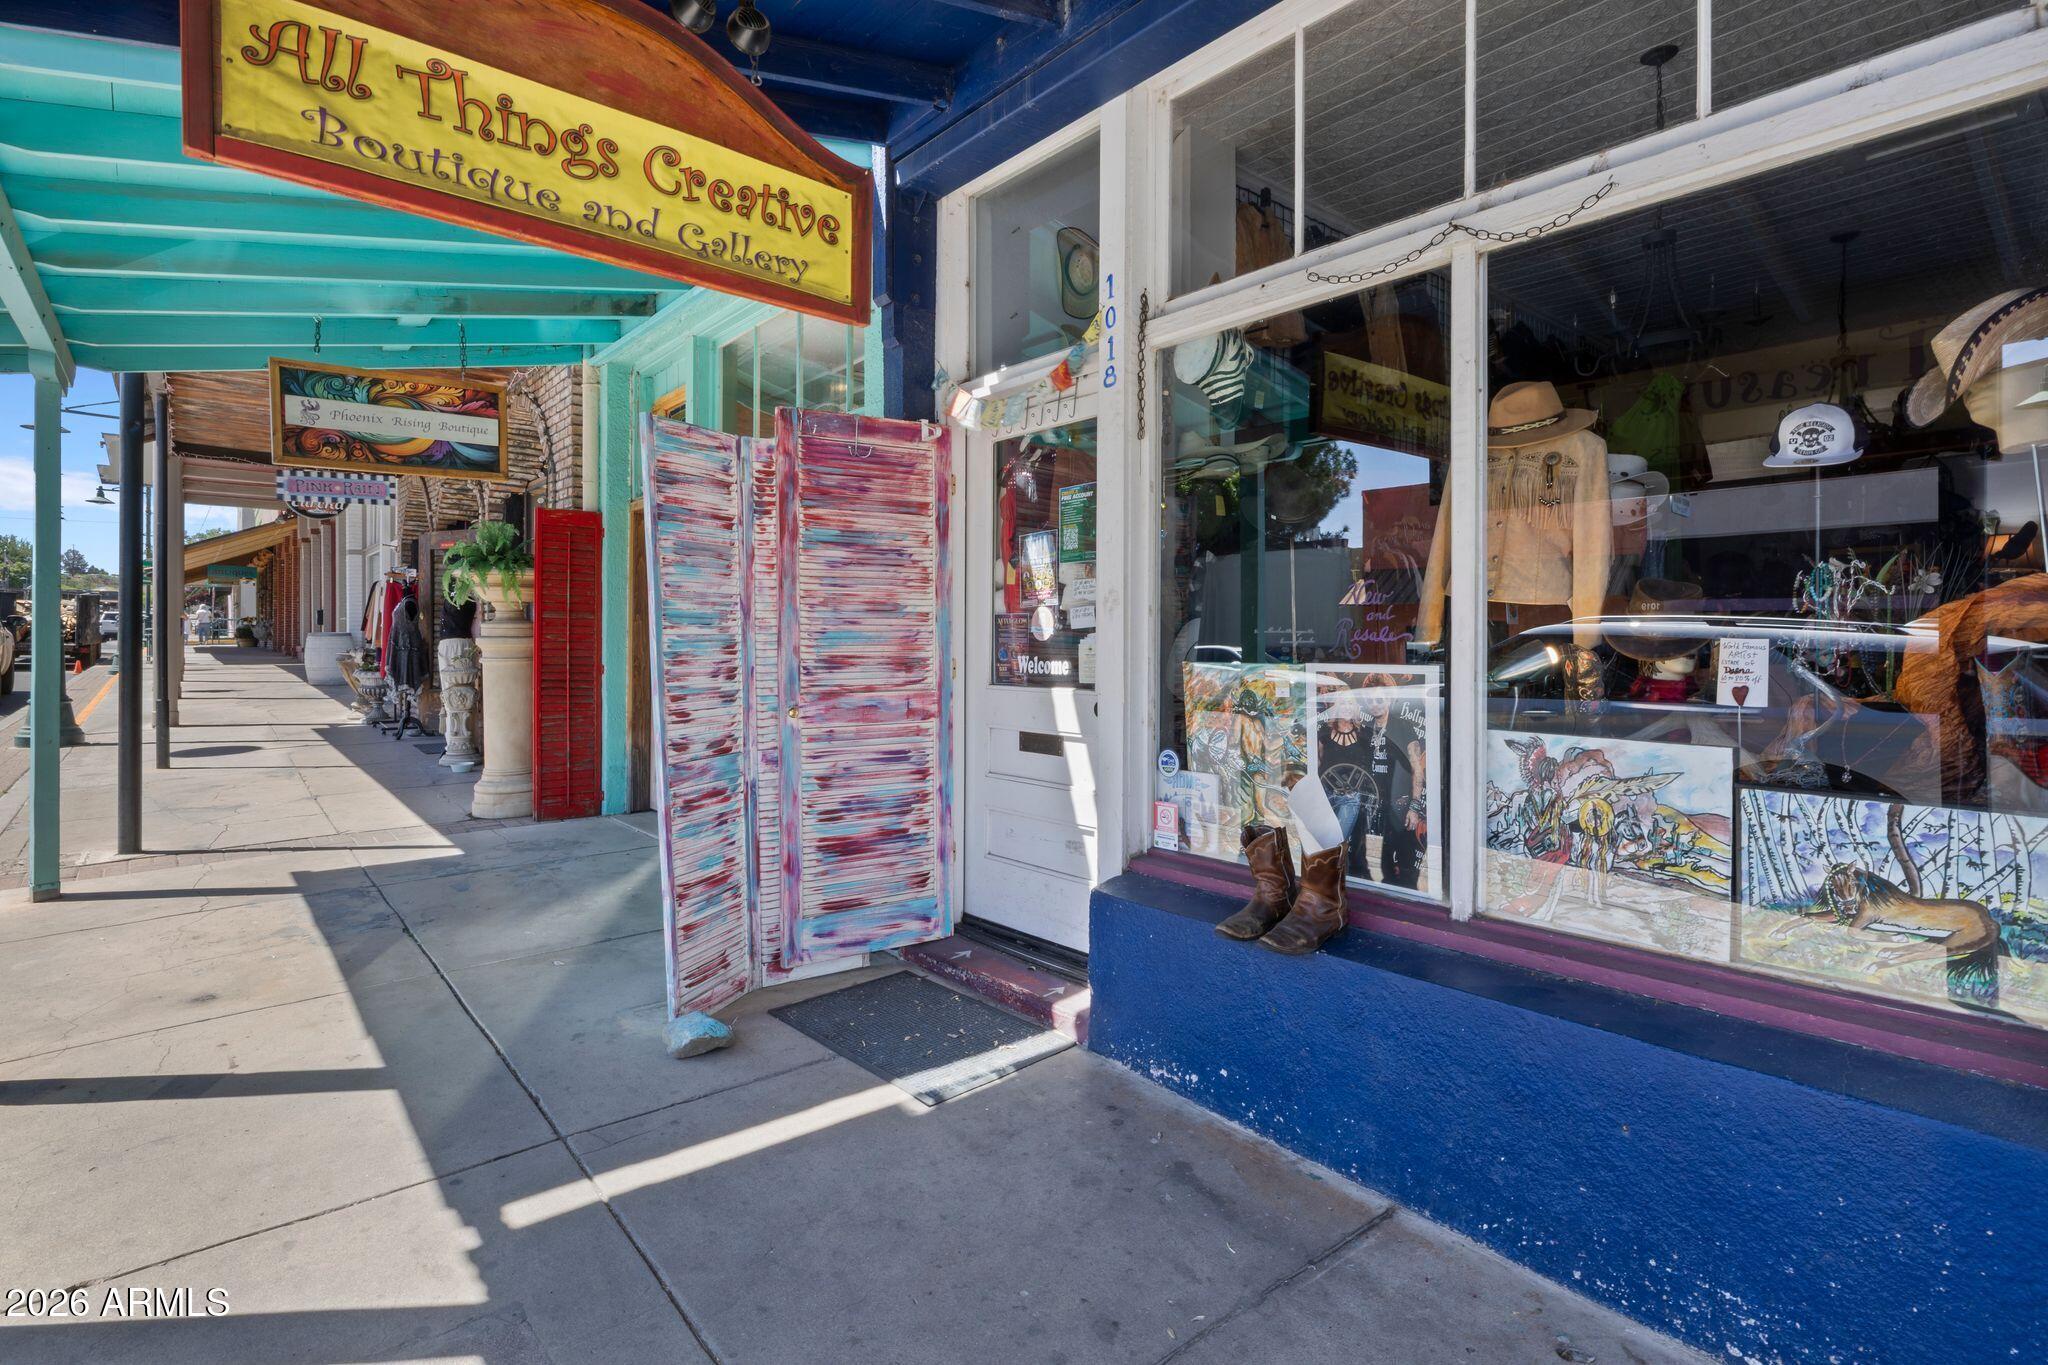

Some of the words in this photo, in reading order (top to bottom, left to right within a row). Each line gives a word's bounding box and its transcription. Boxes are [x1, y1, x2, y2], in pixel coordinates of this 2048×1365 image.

[241, 20, 373, 100] All
[396, 57, 619, 180] Things
[643, 145, 841, 245] Creative
[301, 106, 561, 213] Boutique
[583, 199, 659, 242] and
[677, 221, 809, 284] Gallery
[1103, 273, 1118, 389] 1018
[330, 409, 383, 425] Phoenix
[391, 416, 432, 432] Rising
[438, 421, 489, 437] Boutique
[1346, 579, 1393, 605] New
[1367, 605, 1396, 621] and
[1330, 618, 1414, 659] Resale
[1018, 655, 1070, 675] Welcome
